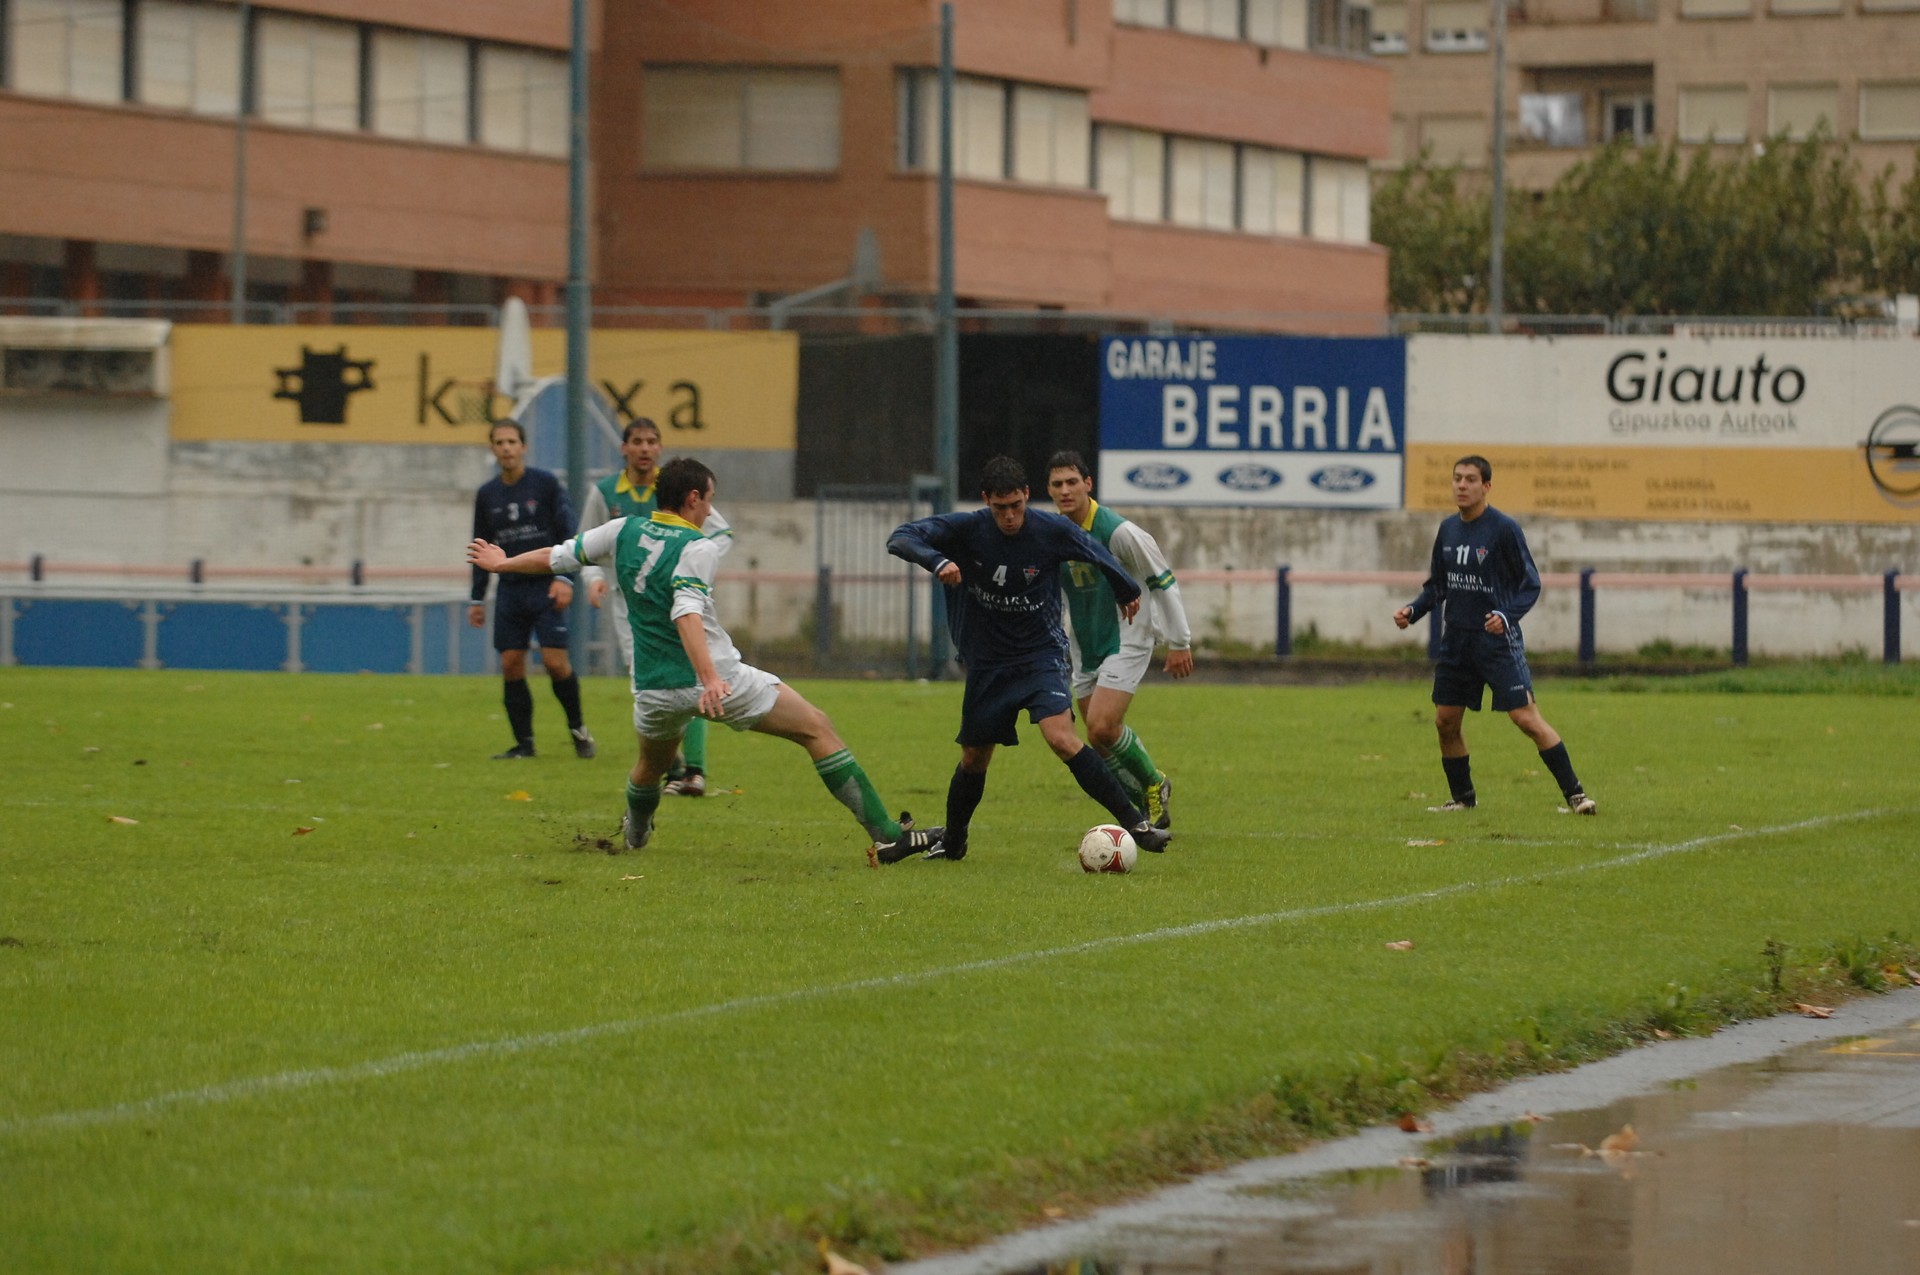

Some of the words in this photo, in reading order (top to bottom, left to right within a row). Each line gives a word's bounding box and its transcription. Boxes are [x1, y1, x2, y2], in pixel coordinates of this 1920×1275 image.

[1106, 339, 1217, 381] GARAJE
[1606, 348, 1806, 405] Giauto
[417, 352, 708, 430] kxa
[1161, 384, 1397, 450] BERRIA
[1609, 408, 1712, 433] Gipuzkoa
[1720, 408, 1798, 432] Autoak
[507, 502, 520, 521] 3
[633, 533, 666, 594] 7
[992, 565, 1008, 586] 4
[1456, 544, 1470, 565] 11
